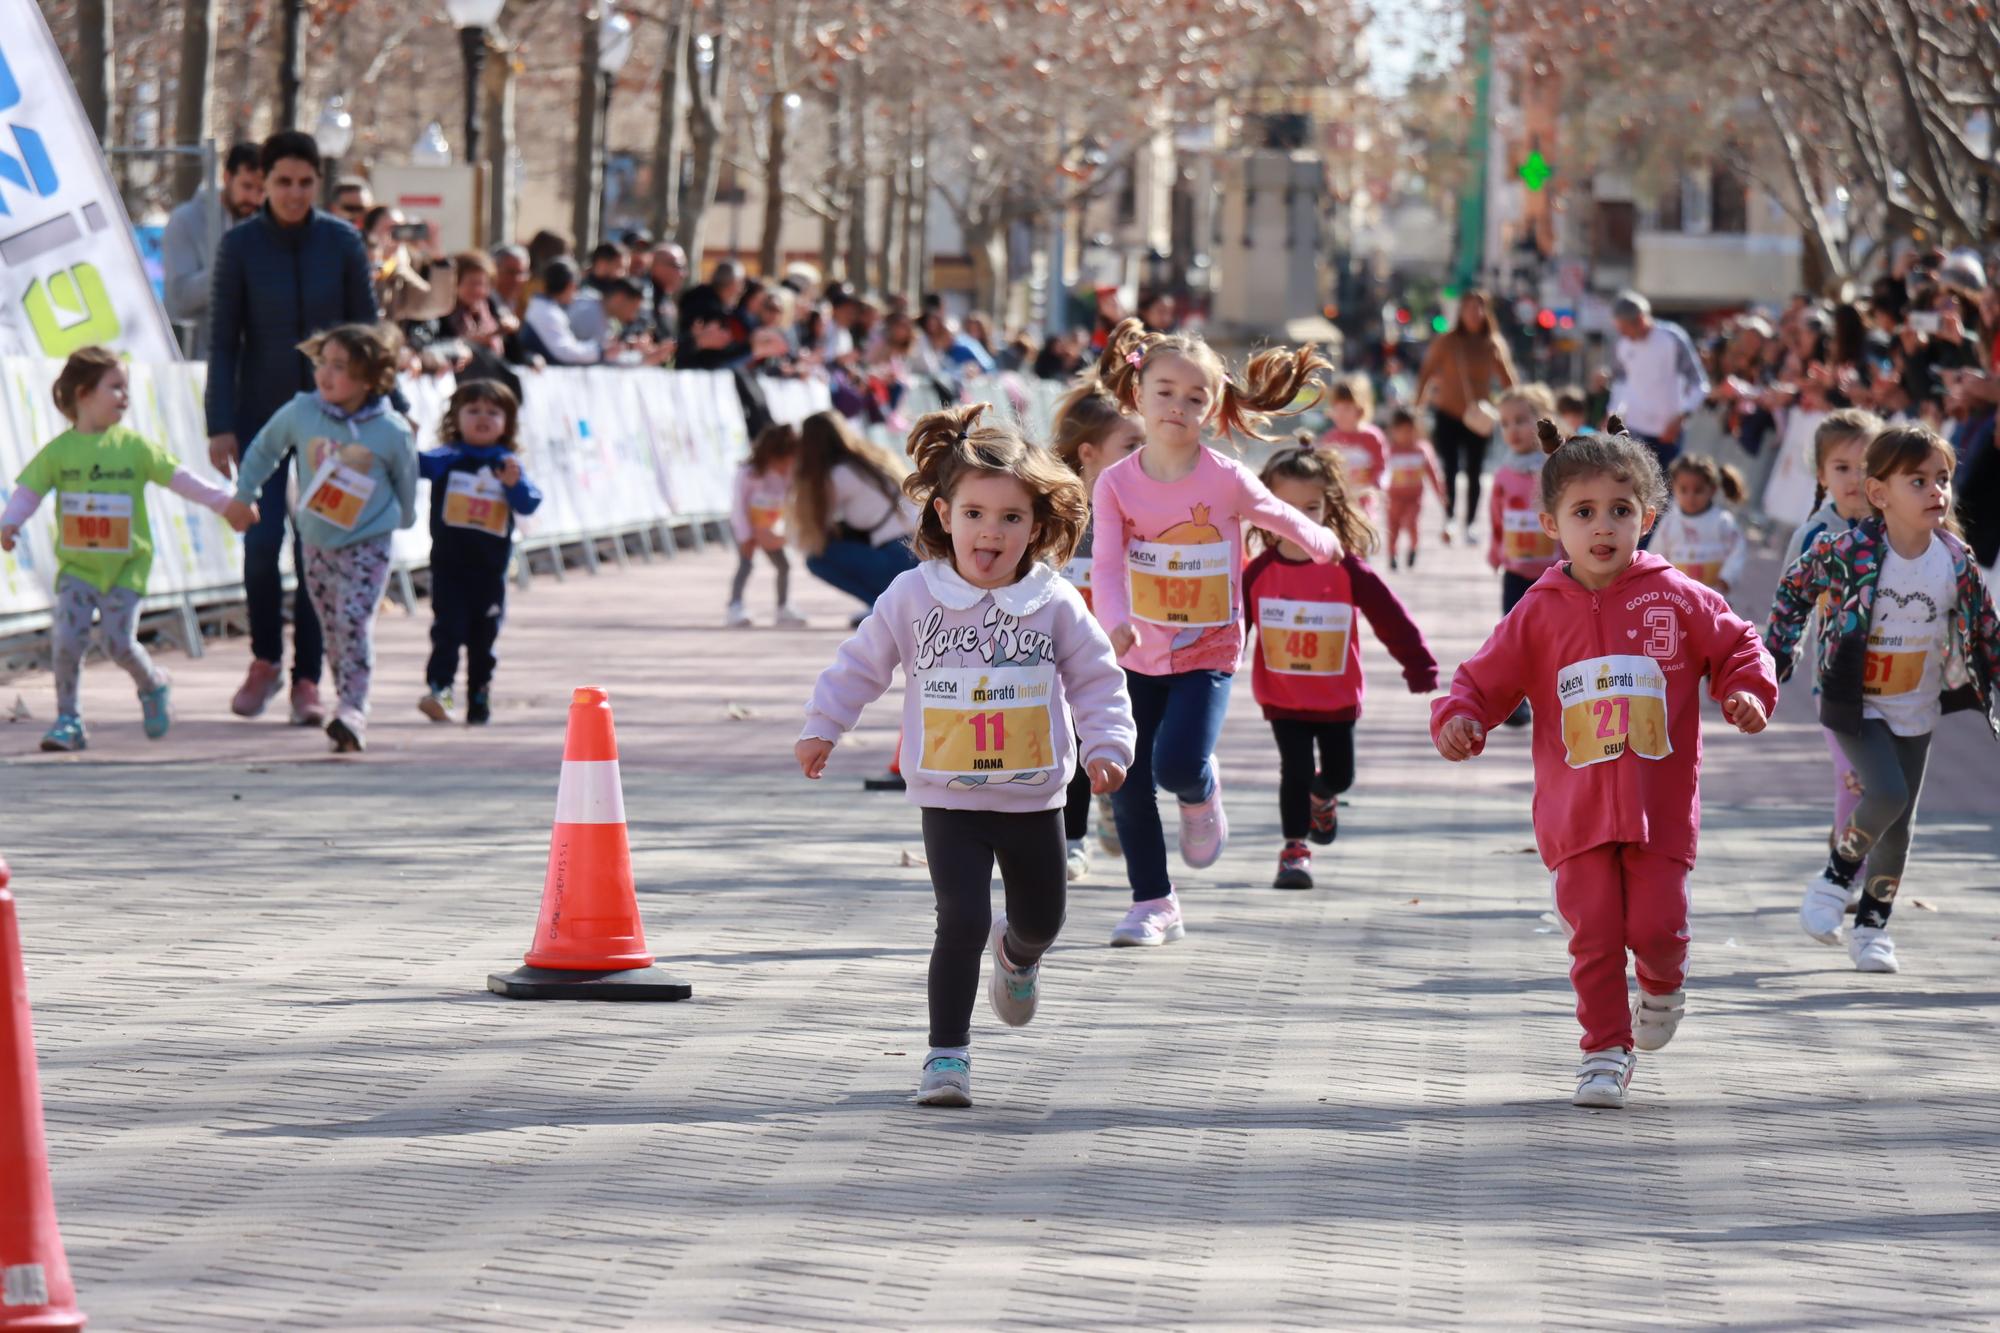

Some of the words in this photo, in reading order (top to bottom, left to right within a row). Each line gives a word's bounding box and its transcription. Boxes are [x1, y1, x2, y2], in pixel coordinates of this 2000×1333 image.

[1168, 558, 1201, 571] marató
[1154, 577, 1202, 609] 137
[1626, 591, 1660, 611] GOOD
[1662, 591, 1694, 615] VIBES
[912, 605, 979, 676] Love
[1285, 631, 1318, 659] 48
[1643, 606, 1678, 660] 3
[1662, 662, 1686, 672] EAGUE
[1864, 651, 1893, 682] 61
[924, 680, 957, 693] SALERA
[973, 685, 1015, 702] marató
[1017, 681, 1048, 698] Infantil
[1597, 673, 1633, 690] marató
[1593, 697, 1629, 739] 27
[969, 712, 1004, 752] 11
[972, 758, 1004, 770] JOANA
